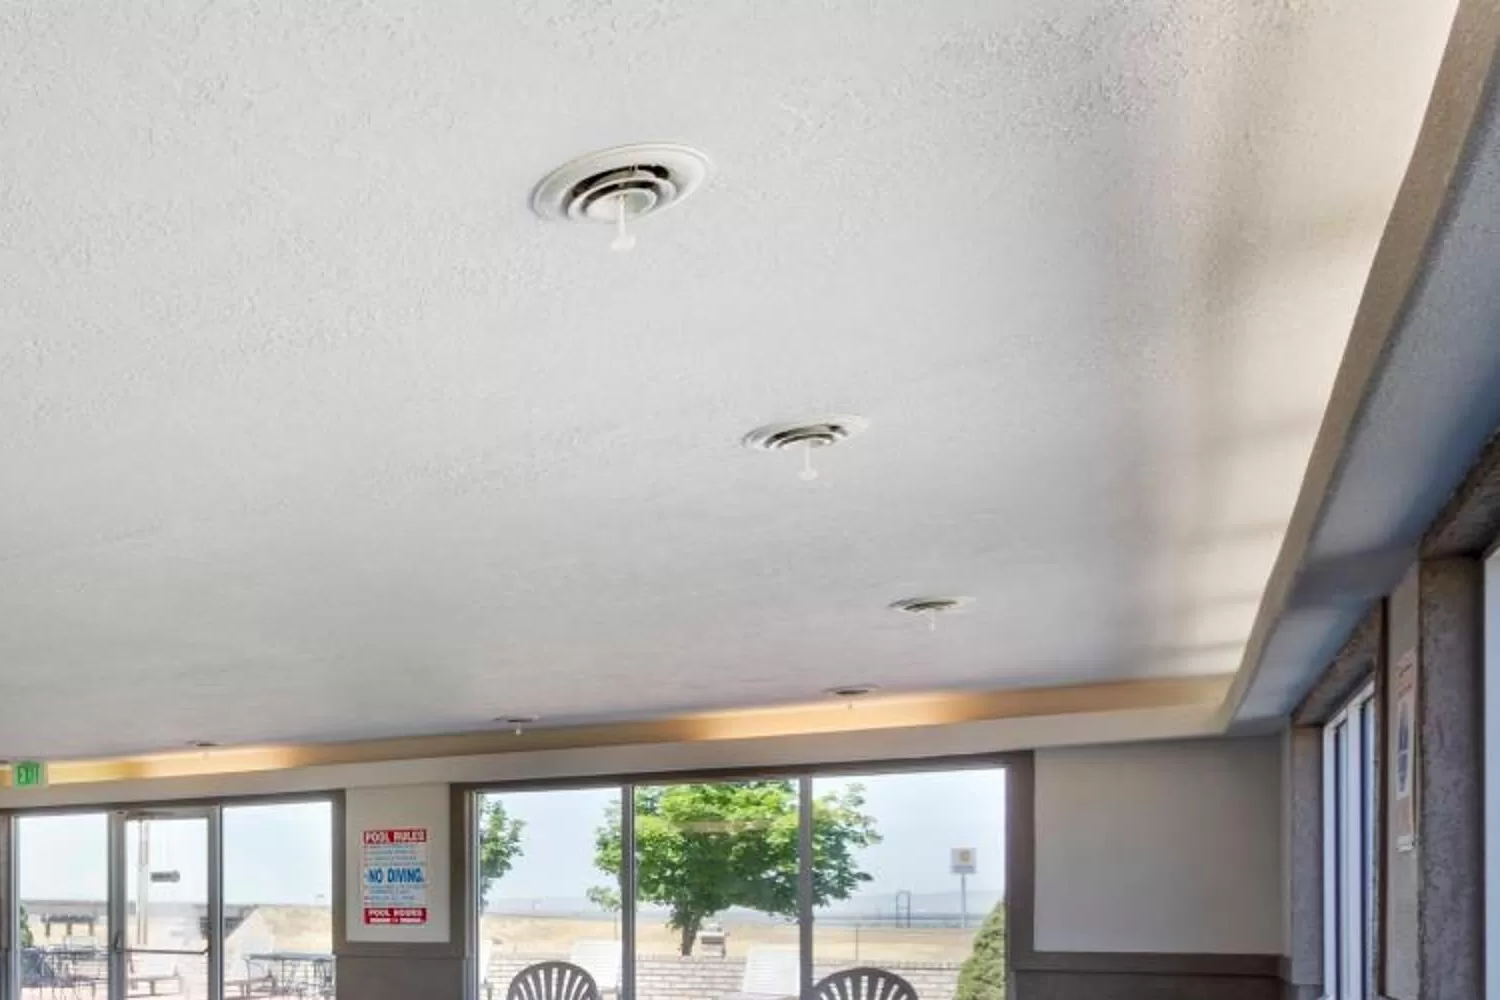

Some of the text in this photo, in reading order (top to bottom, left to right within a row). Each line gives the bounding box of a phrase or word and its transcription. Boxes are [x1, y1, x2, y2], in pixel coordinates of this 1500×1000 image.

[17, 765, 39, 785] EXIT
[365, 830, 424, 842] POOL RULES
[369, 868, 383, 883] NO
[368, 909, 388, 918] POOL
